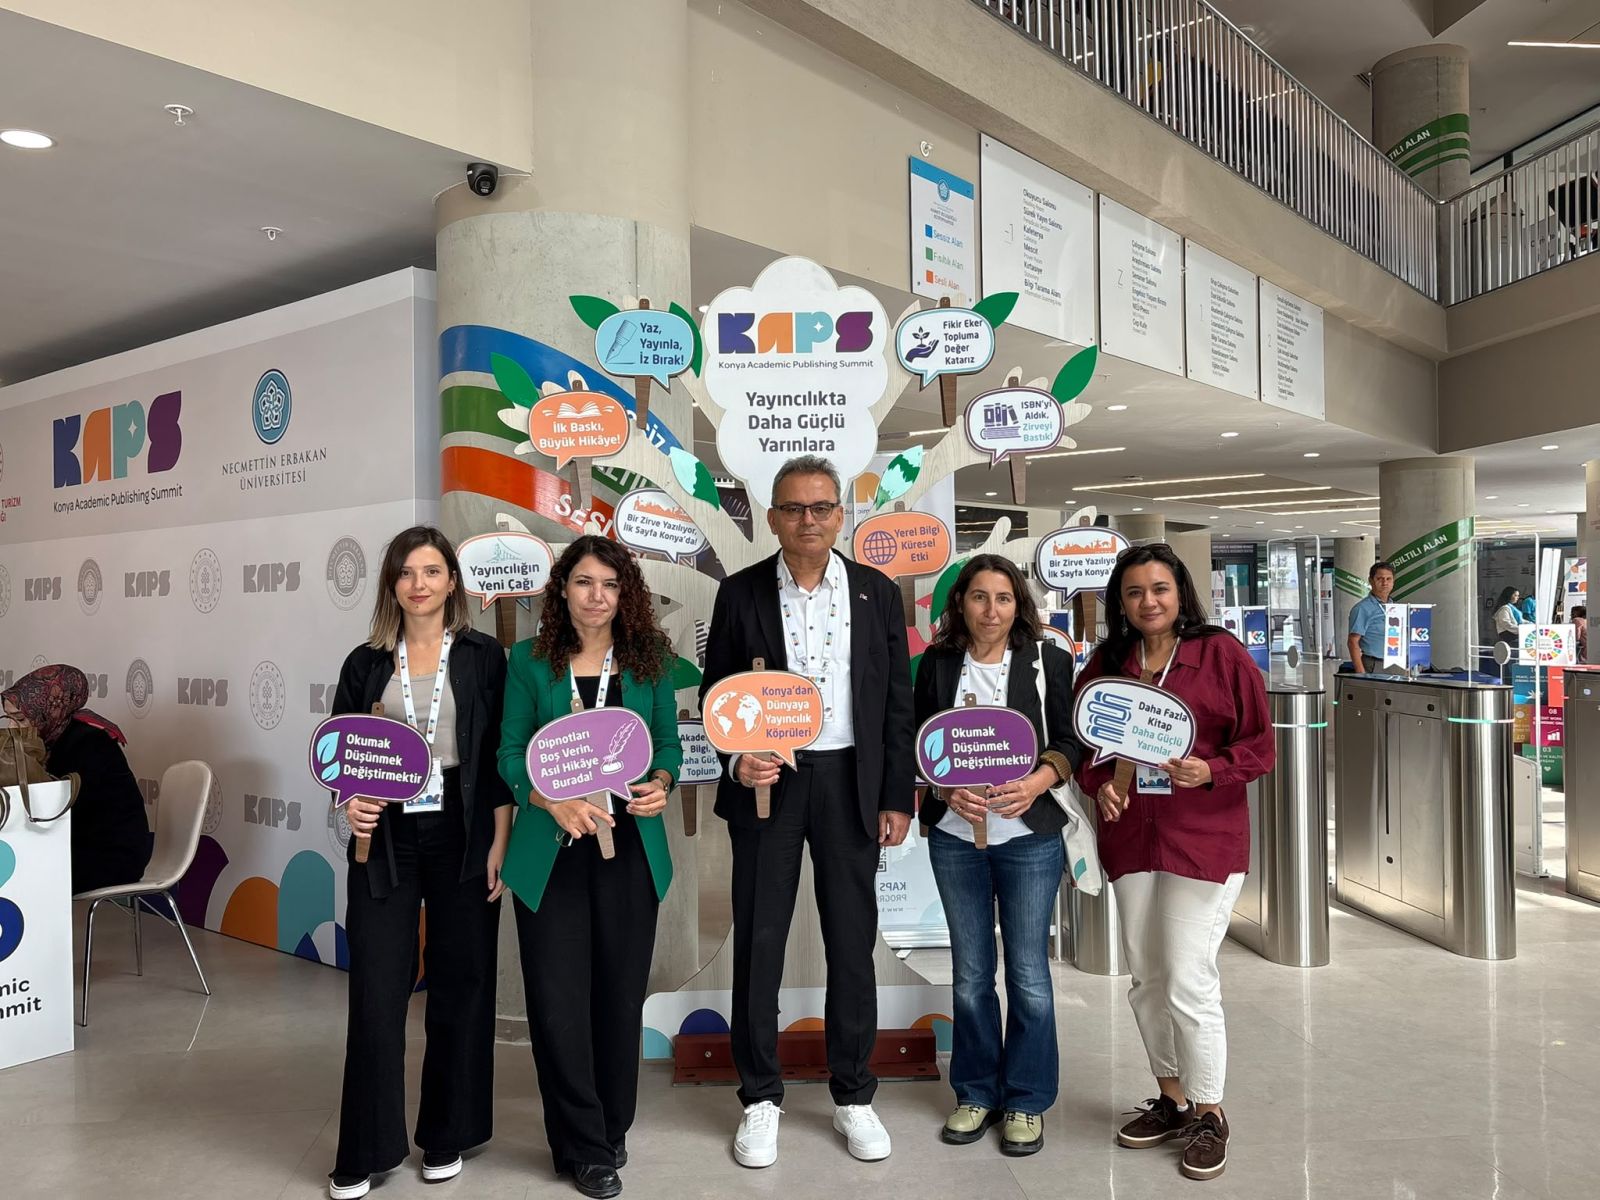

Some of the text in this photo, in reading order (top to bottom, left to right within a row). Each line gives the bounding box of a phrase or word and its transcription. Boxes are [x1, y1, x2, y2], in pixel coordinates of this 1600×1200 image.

[1405, 129, 1431, 149] ALAN
[640, 322, 662, 335] Yaz,
[943, 319, 983, 330] Fikir Eker
[718, 311, 873, 354] KAPS
[944, 331, 979, 342] Topluma
[640, 338, 683, 351] Yayınla,
[944, 343, 970, 354] Değer
[640, 353, 684, 365] İz Bırak!
[718, 360, 873, 370] Konya Academic Publishing Summit
[945, 356, 975, 366] Katarız
[746, 391, 846, 408] Yayıncılıkta
[748, 413, 845, 432] Daha Güçlü
[1024, 411, 1050, 421] Aldık,
[553, 421, 604, 433] İlk Baskı,
[1022, 422, 1053, 432] Zirveyi
[53, 390, 182, 489] KAPS
[539, 434, 620, 449] Büyük Hikâye!
[759, 437, 834, 452] Yarınlara
[1023, 433, 1053, 442] Bastık!
[222, 447, 327, 476] NECMETTİN ERBAKAN
[240, 470, 307, 491] ÜNİVERSİTESİ
[53, 484, 183, 514] Konya Academic Publishing Summit
[627, 514, 697, 535] Bir Zirve Yazılıyor,
[894, 525, 941, 539] Yerel Bilgi
[623, 522, 698, 546] İlk Sayfa Konya'da!
[901, 538, 936, 550] Küresel
[1391, 534, 1448, 568] ISILTILI ALAN
[910, 551, 929, 562] Etki
[1049, 557, 1116, 568] Bir Zirve Yazılıyo
[243, 561, 301, 593] KAPS
[470, 562, 540, 577] Yayıncılığın
[1048, 567, 1112, 578] İlk Sayfa Konya'
[25, 577, 61, 601] KAPS
[124, 570, 170, 598] KAPS
[478, 578, 534, 591] Yeni Çağı
[178, 678, 228, 707] KAPS
[762, 685, 813, 697] Konya'dan
[767, 700, 809, 712] Dünyaya
[1138, 701, 1188, 723] Daha Fazla
[765, 713, 812, 726] Yayıncılık
[1147, 716, 1172, 733] Kitap
[681, 733, 706, 742] Akade
[766, 727, 811, 739] Köprüleri
[951, 726, 995, 738] Okumak
[1132, 725, 1183, 747] Daha Güçlü
[346, 733, 391, 749] Okumak
[538, 730, 590, 750] Dipnotları
[953, 740, 1010, 755] Düşünmek
[540, 744, 594, 763] Boş Verin,
[1137, 739, 1172, 757] Yarınlar
[345, 749, 402, 766] Düşünmek
[684, 757, 699, 765] aha
[954, 753, 1032, 770] Değiştirmektir
[343, 764, 422, 784] Değiştirmektir
[541, 757, 599, 778] Asıl Hikâye
[687, 768, 716, 777] Toplum
[552, 771, 593, 790] Burada!
[244, 794, 302, 831] KAPS
[0, 978, 30, 997] mic
[0, 997, 42, 1019] mit
